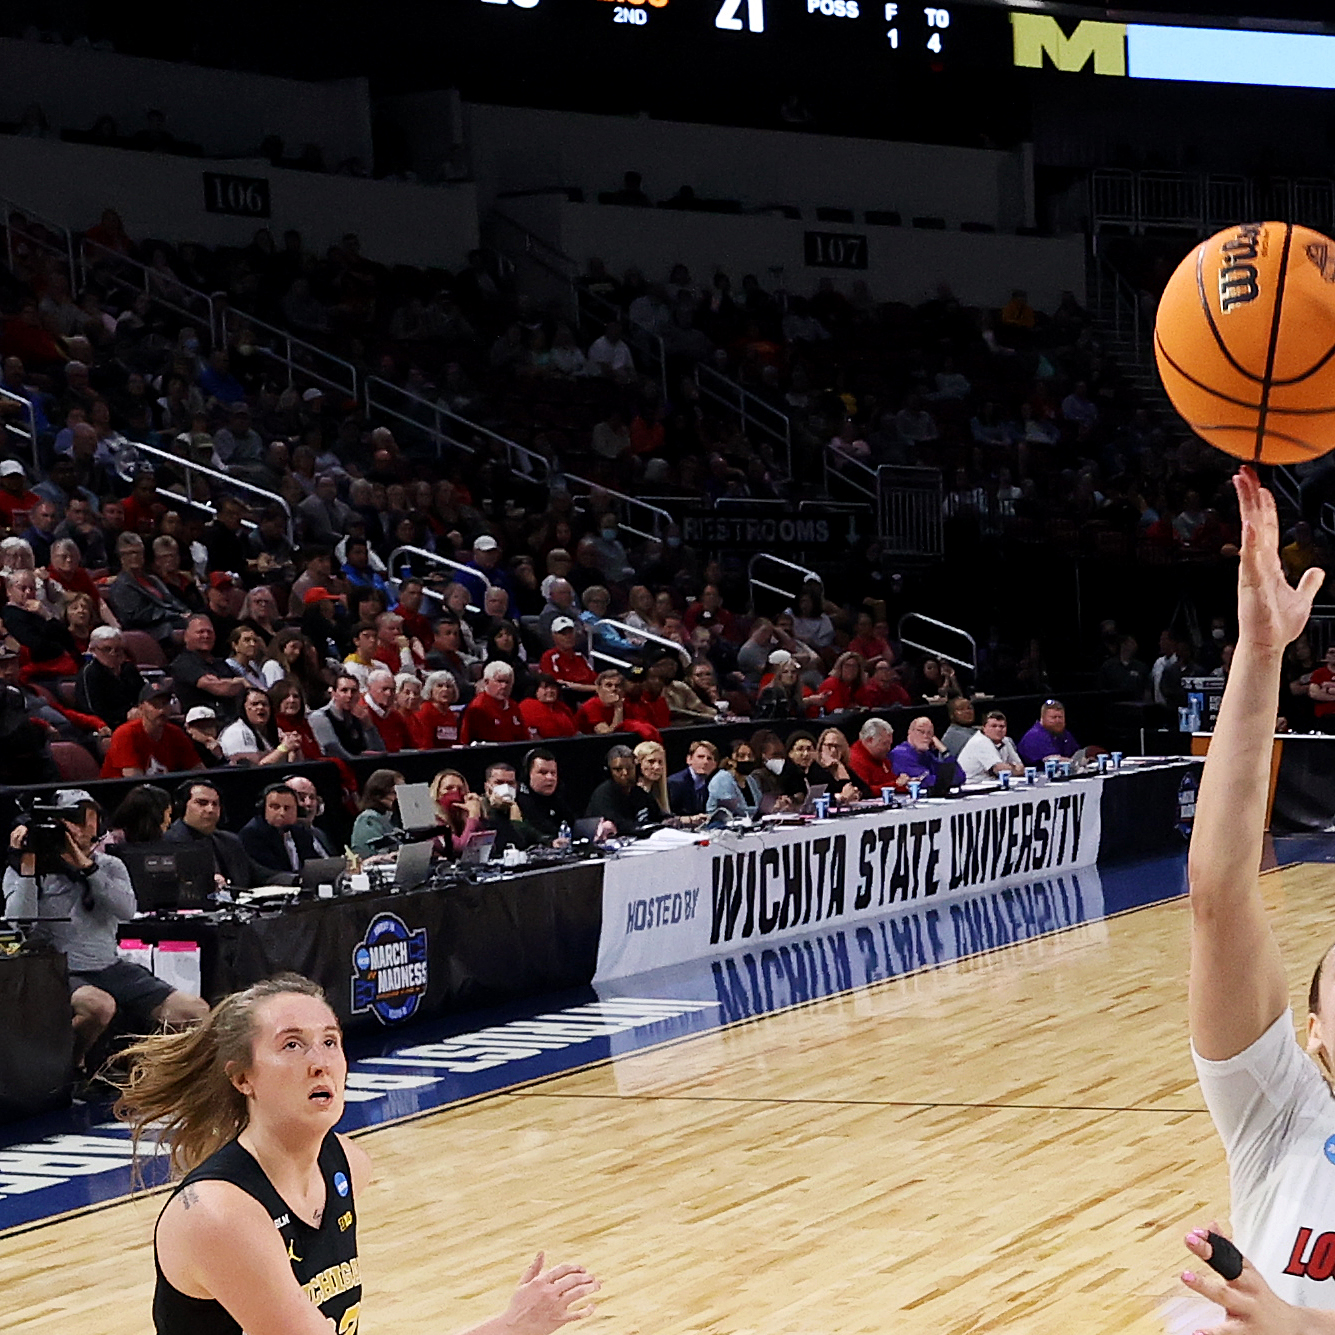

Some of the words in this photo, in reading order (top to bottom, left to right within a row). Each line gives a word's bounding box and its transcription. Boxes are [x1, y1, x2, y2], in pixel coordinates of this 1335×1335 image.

[613, 6, 648, 26] 2ND
[807, 0, 860, 19] POSS
[885, 2, 898, 21] F
[924, 7, 950, 28] TO
[887, 28, 898, 48] 1
[926, 33, 942, 53] 4
[213, 178, 262, 212] 106
[815, 236, 861, 265] 107
[683, 517, 829, 543] RESTROOMS
[626, 892, 683, 934] HOSTED
[684, 887, 700, 920] BY
[709, 834, 847, 945] WICHITA
[854, 818, 942, 910] STATE
[948, 792, 1086, 891] UNIVERSITY
[368, 941, 408, 971] MARCH
[378, 961, 428, 994] MADNESS
